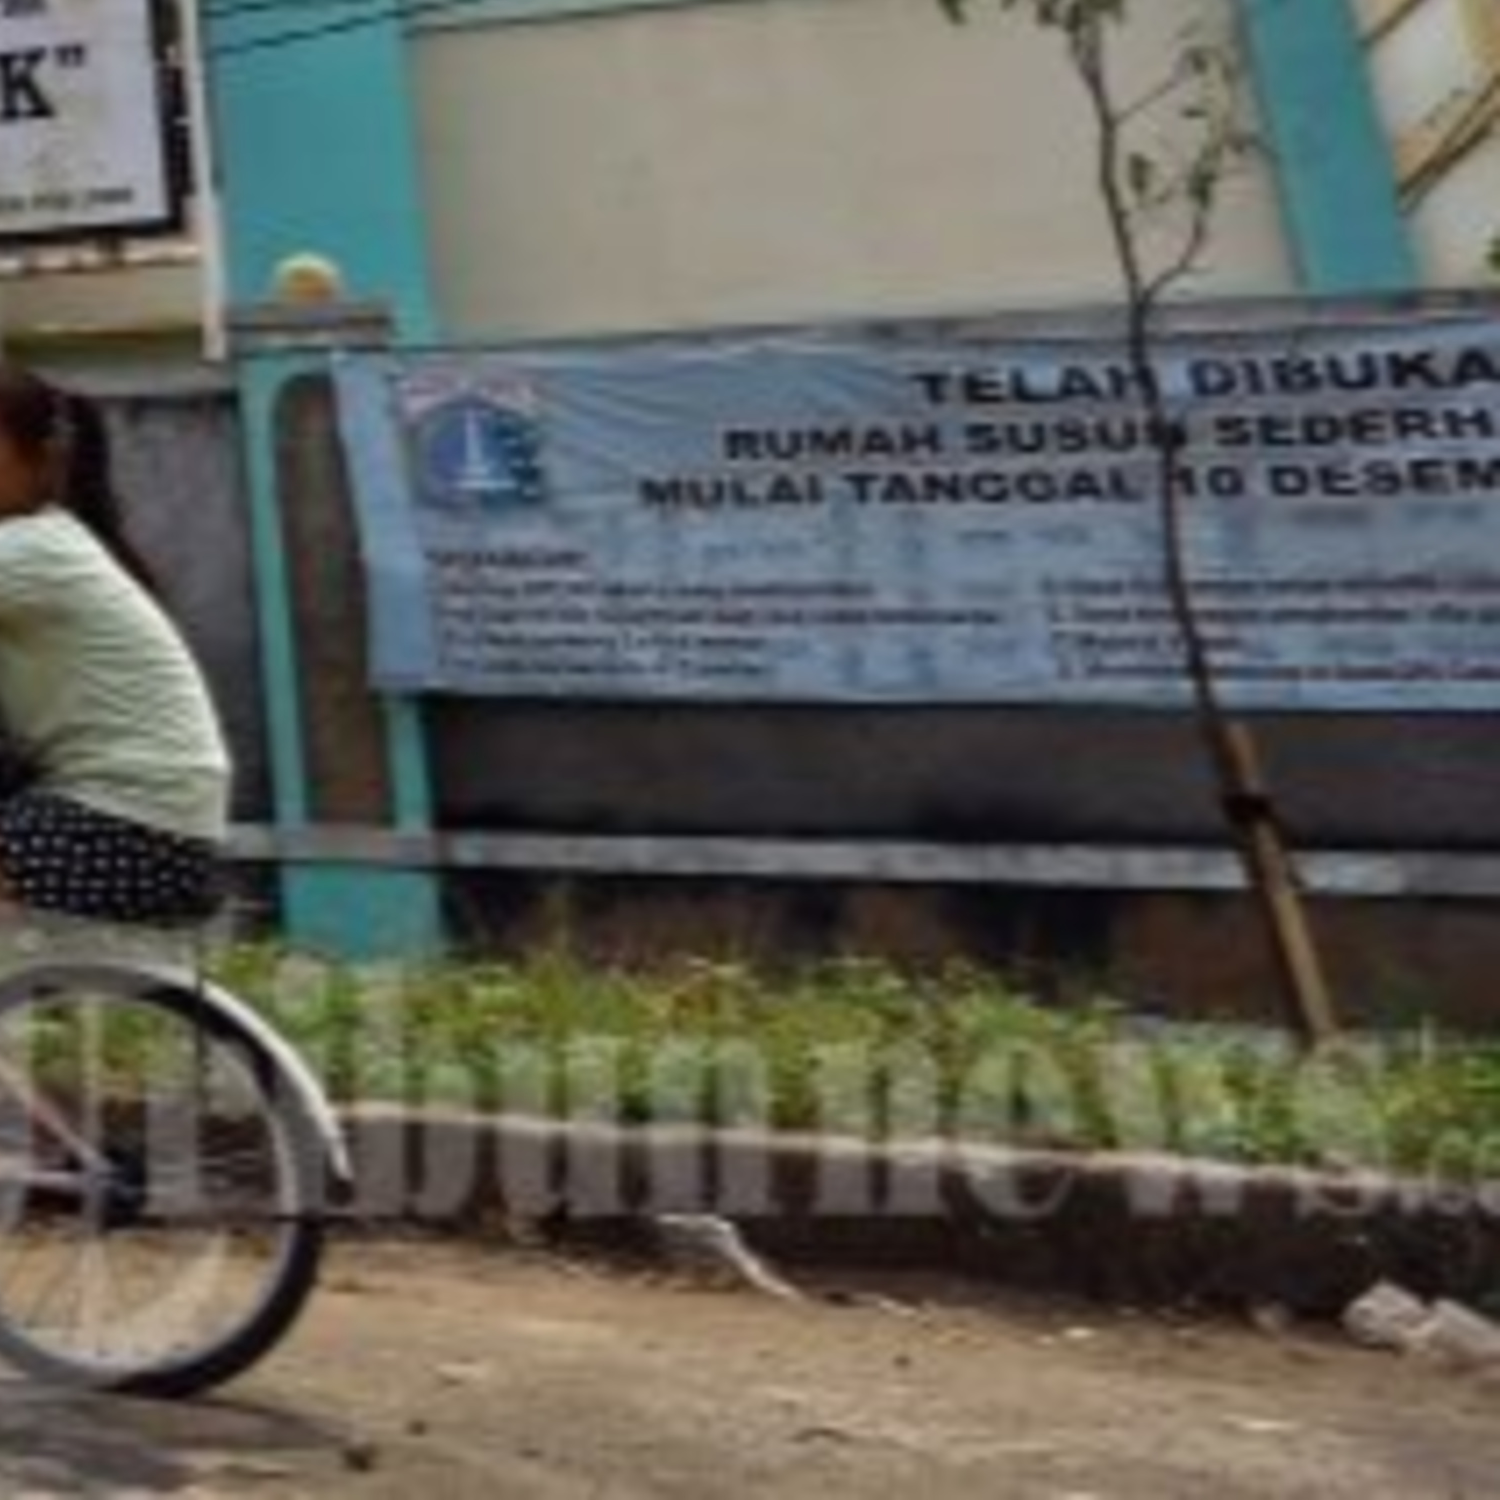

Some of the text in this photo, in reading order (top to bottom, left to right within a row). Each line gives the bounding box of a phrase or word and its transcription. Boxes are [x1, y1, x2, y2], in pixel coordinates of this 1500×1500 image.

[912, 348, 1500, 404] TELAH DIBUKA
[722, 423, 943, 460] RUMAH
[1213, 408, 1494, 447] SEDERH
[639, 458, 1500, 508] MULAI TANGGAL 10 DESEM
